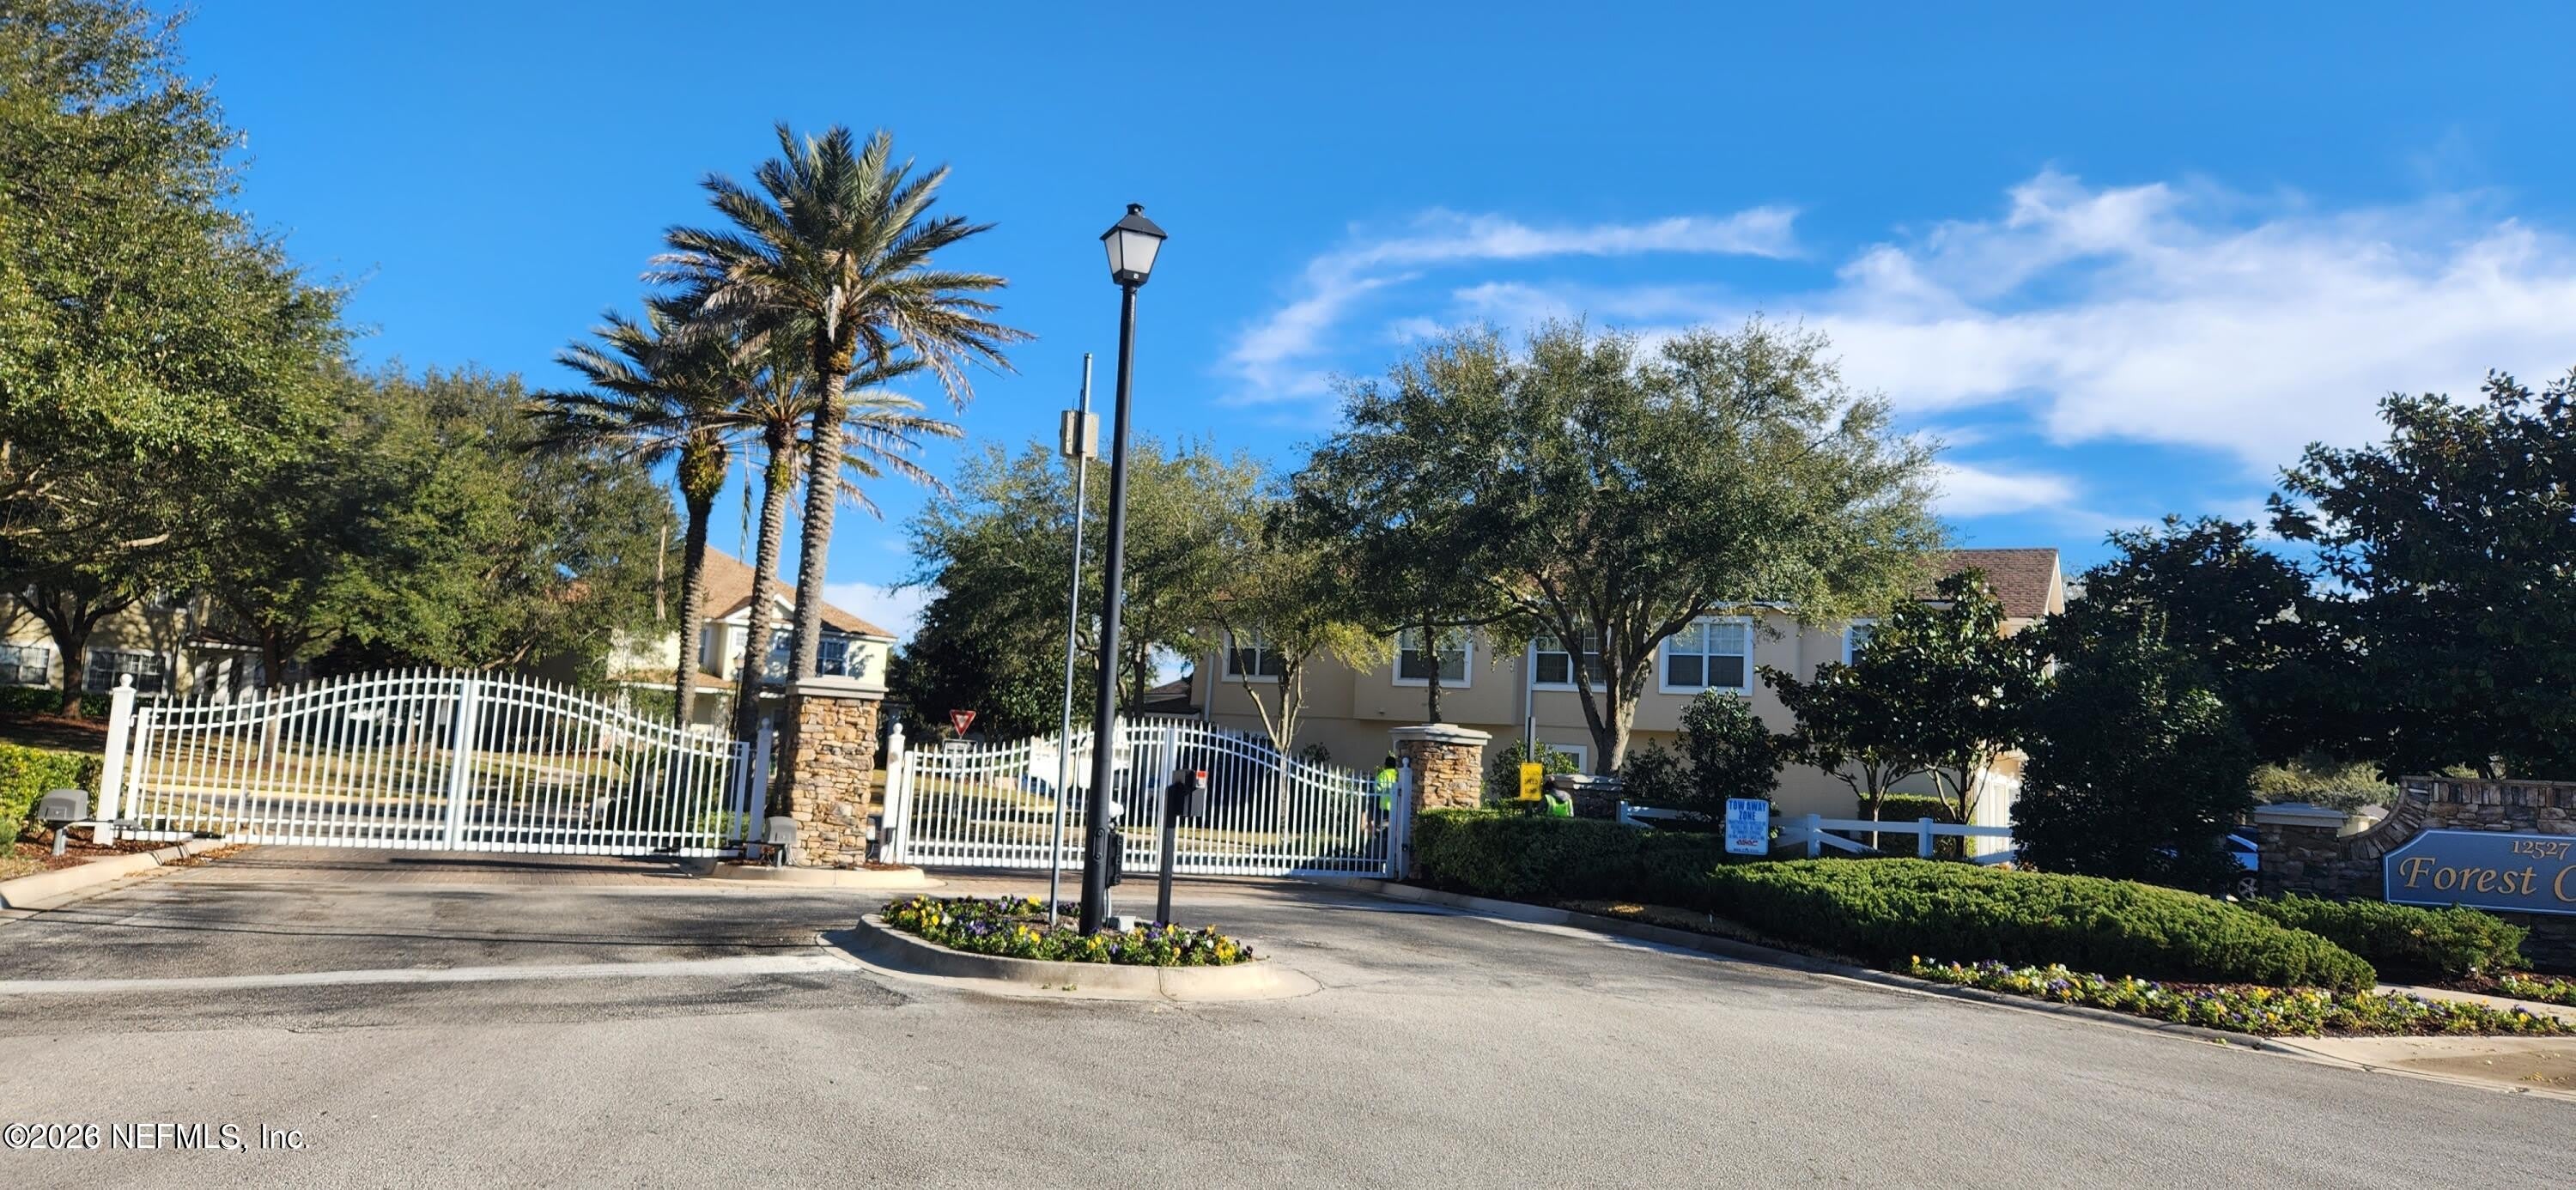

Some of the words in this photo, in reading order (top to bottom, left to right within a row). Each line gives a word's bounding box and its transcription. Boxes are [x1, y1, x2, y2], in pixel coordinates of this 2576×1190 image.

[1728, 800, 1745, 811] TOW
[1746, 801, 1766, 811] AWAY
[1739, 811, 1755, 821] ZONE
[2512, 840, 2571, 860] 12527
[2399, 857, 2537, 896] Forest
